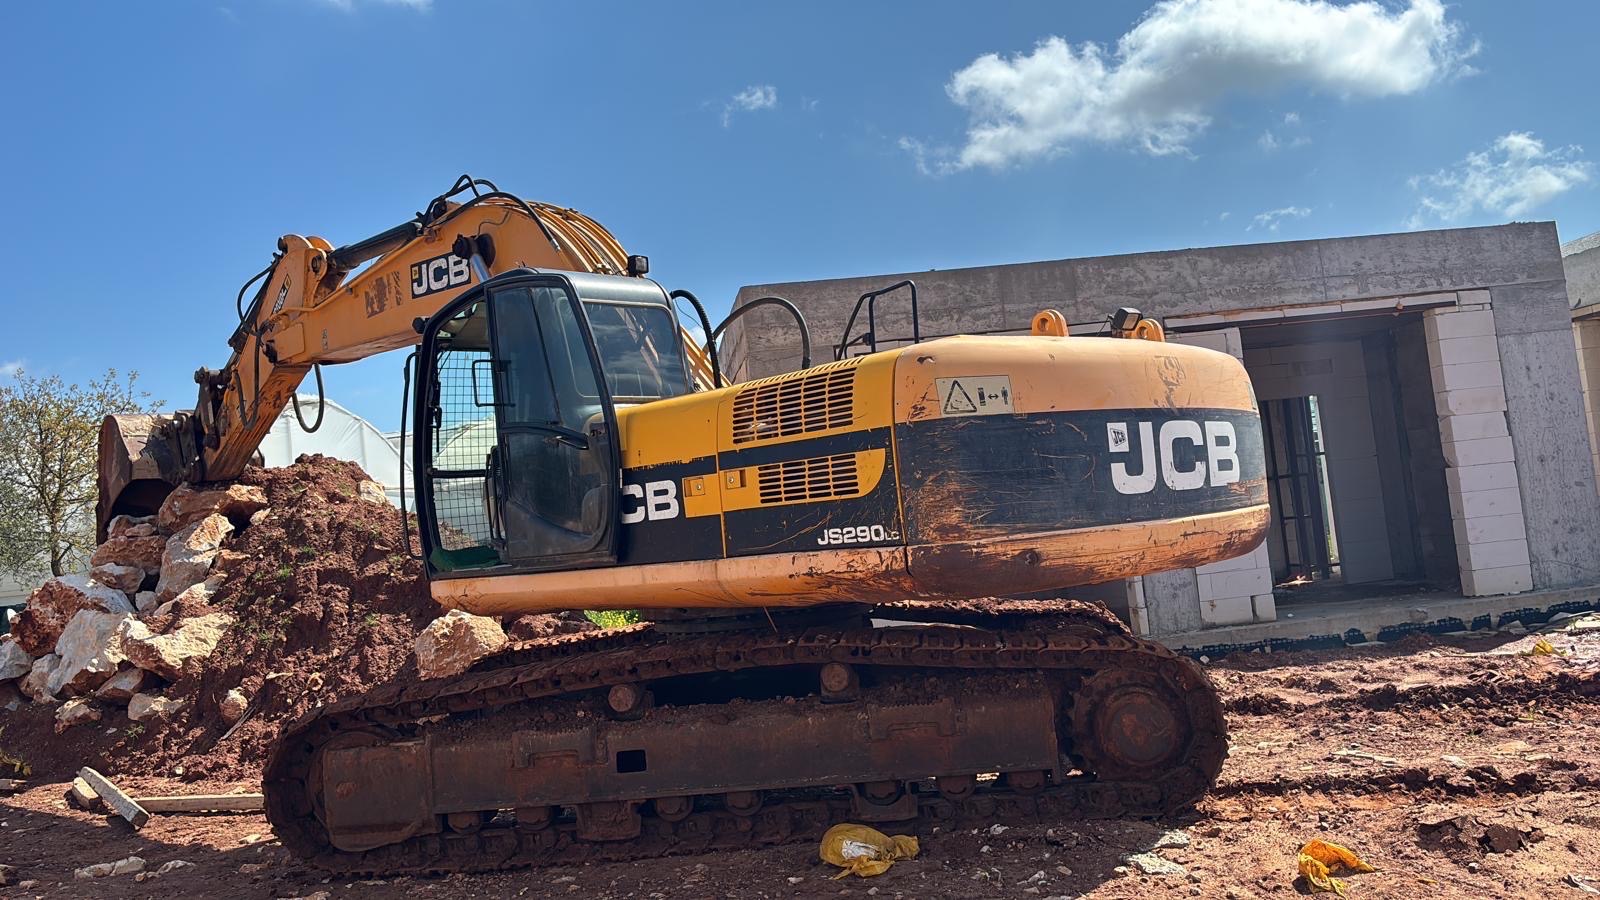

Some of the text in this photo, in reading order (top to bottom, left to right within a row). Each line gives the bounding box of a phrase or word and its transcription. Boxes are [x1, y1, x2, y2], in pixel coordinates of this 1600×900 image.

[412, 254, 470, 295] JCB
[1106, 420, 1240, 495] JCB
[621, 480, 679, 524] CB
